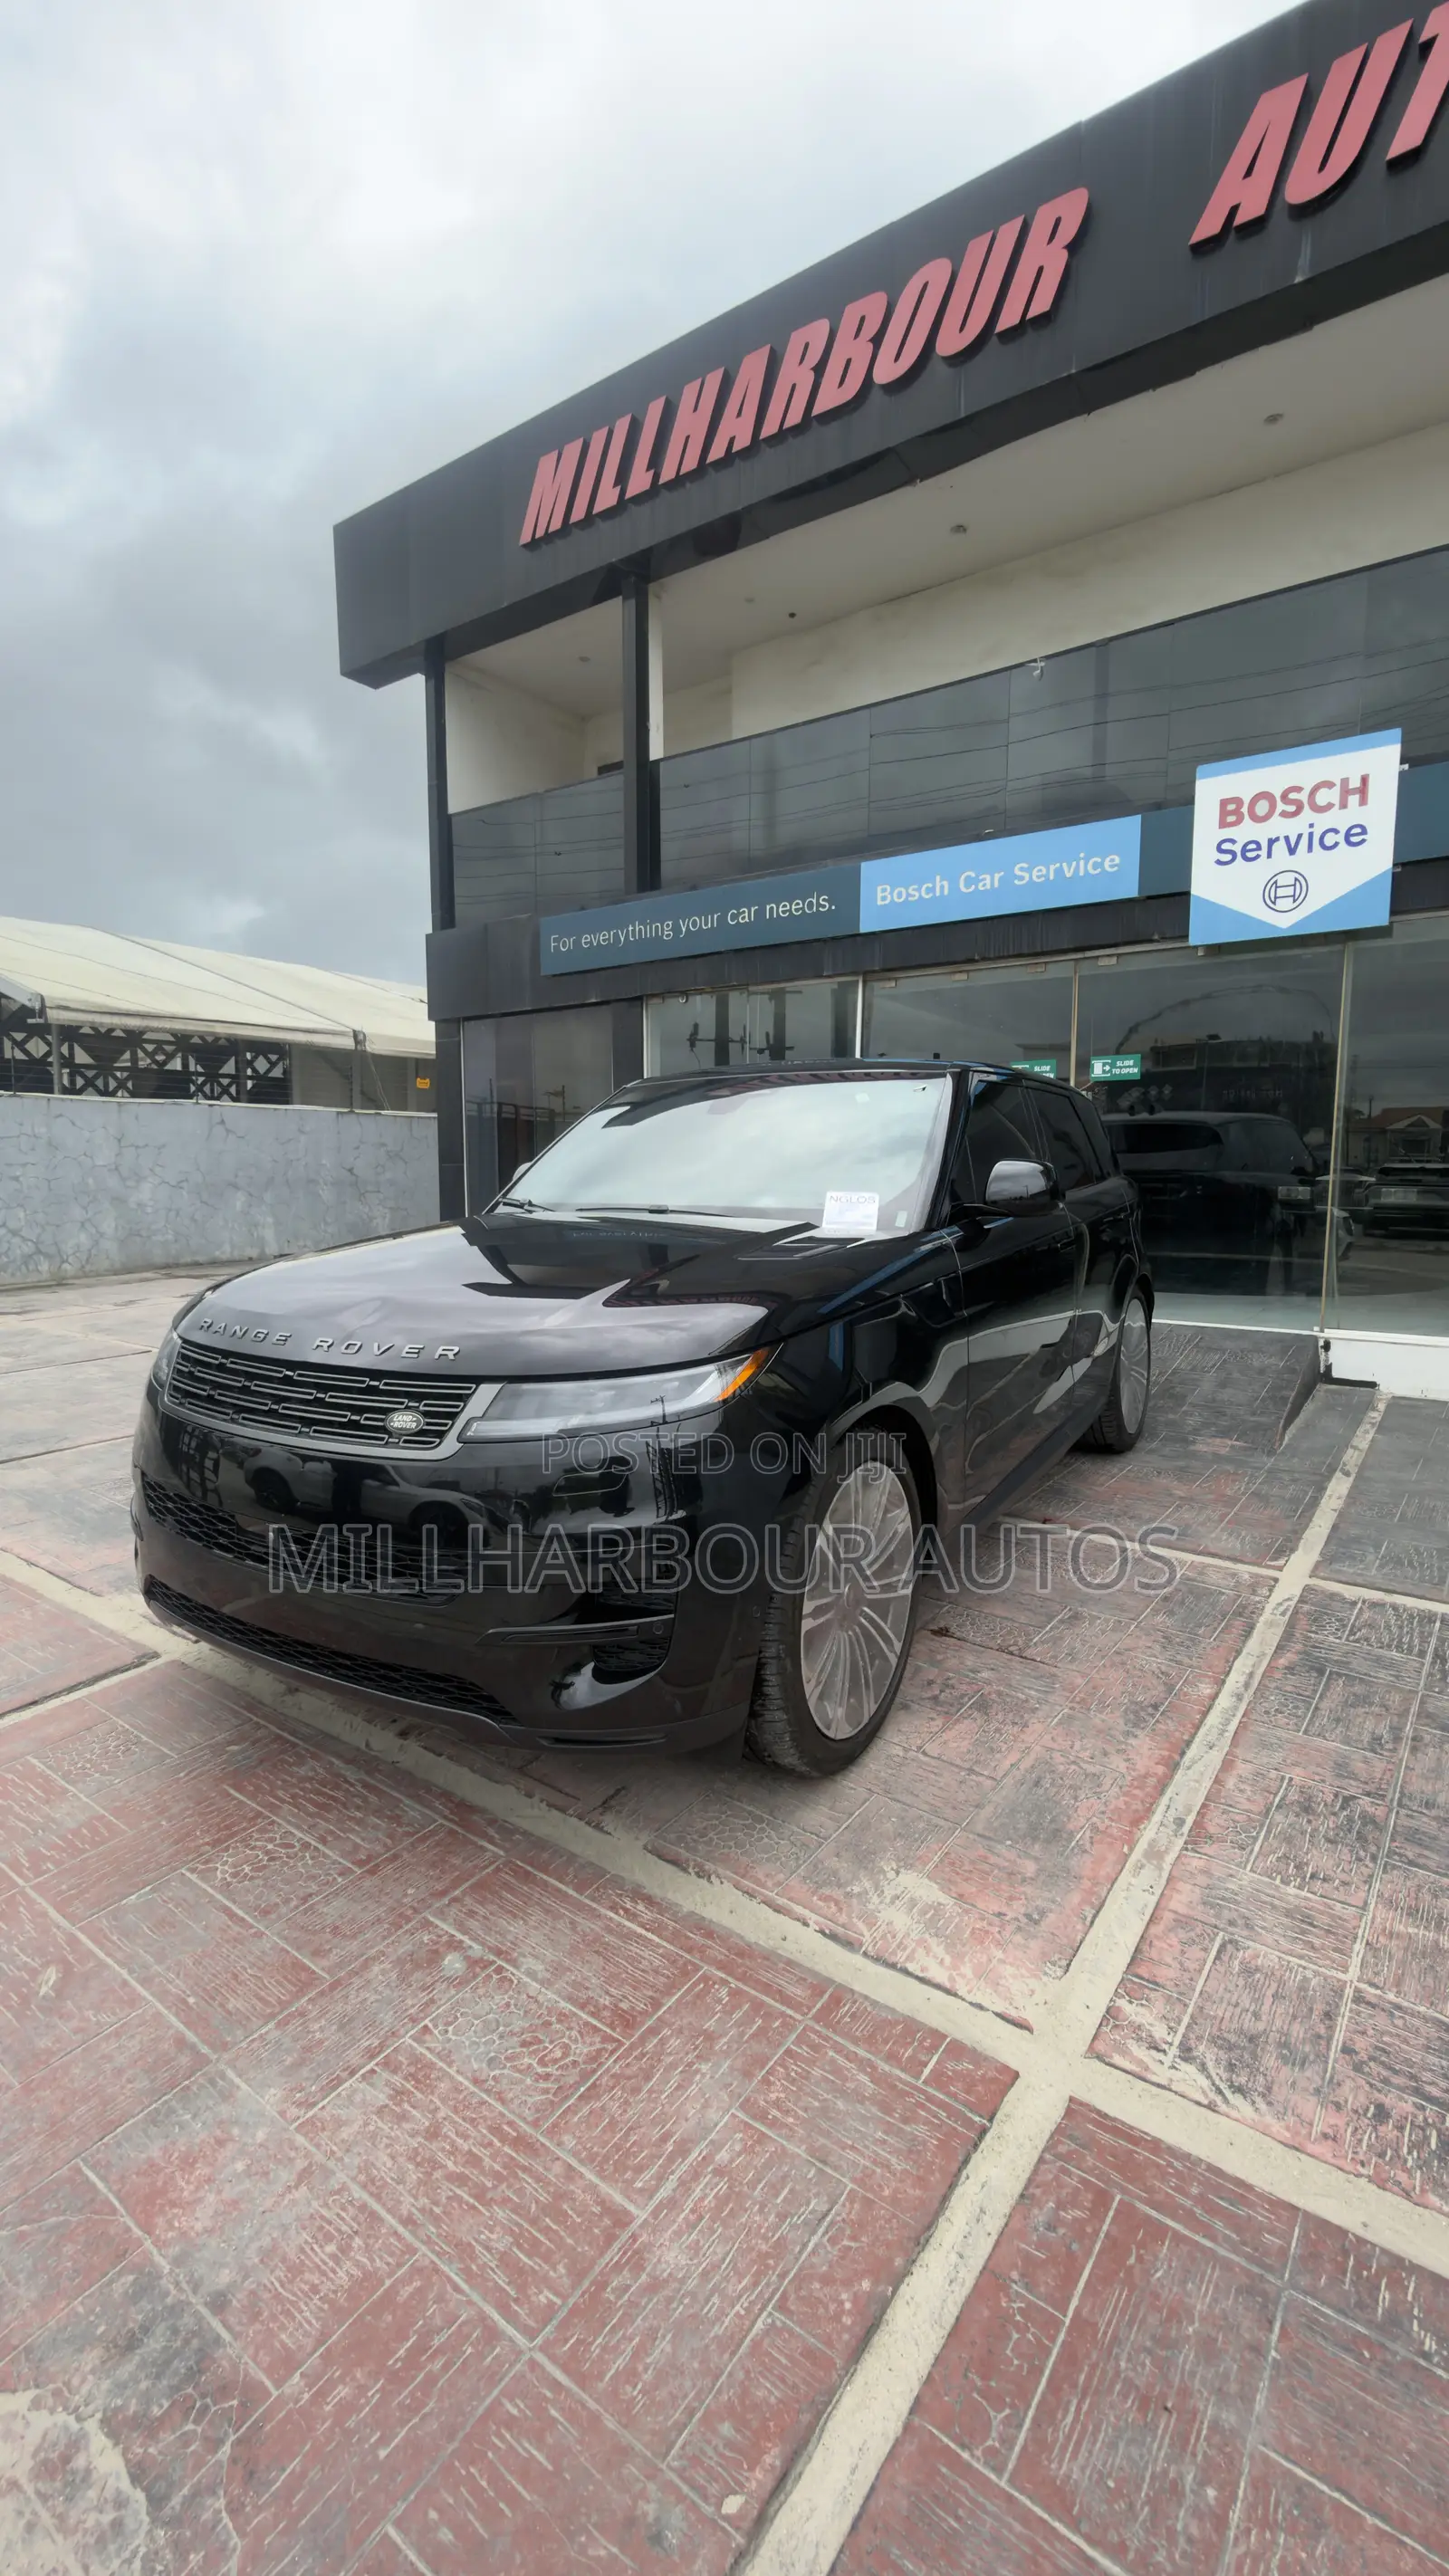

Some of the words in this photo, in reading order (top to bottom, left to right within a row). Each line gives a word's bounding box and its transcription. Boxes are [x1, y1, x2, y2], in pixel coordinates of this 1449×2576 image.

[519, 187, 1089, 546] MILLHARBOUR
[1218, 773, 1370, 829] BOSCH
[1214, 822, 1368, 867] Service
[876, 875, 949, 905] Bosch
[959, 870, 1004, 894] Car
[1013, 852, 1120, 886] Service
[550, 934, 575, 953] For
[581, 918, 673, 947] everything
[678, 912, 721, 937] your
[727, 905, 759, 925] car
[765, 891, 837, 920] needs.
[198, 1317, 292, 1346] RANGE
[312, 1336, 460, 1360] ROVER
